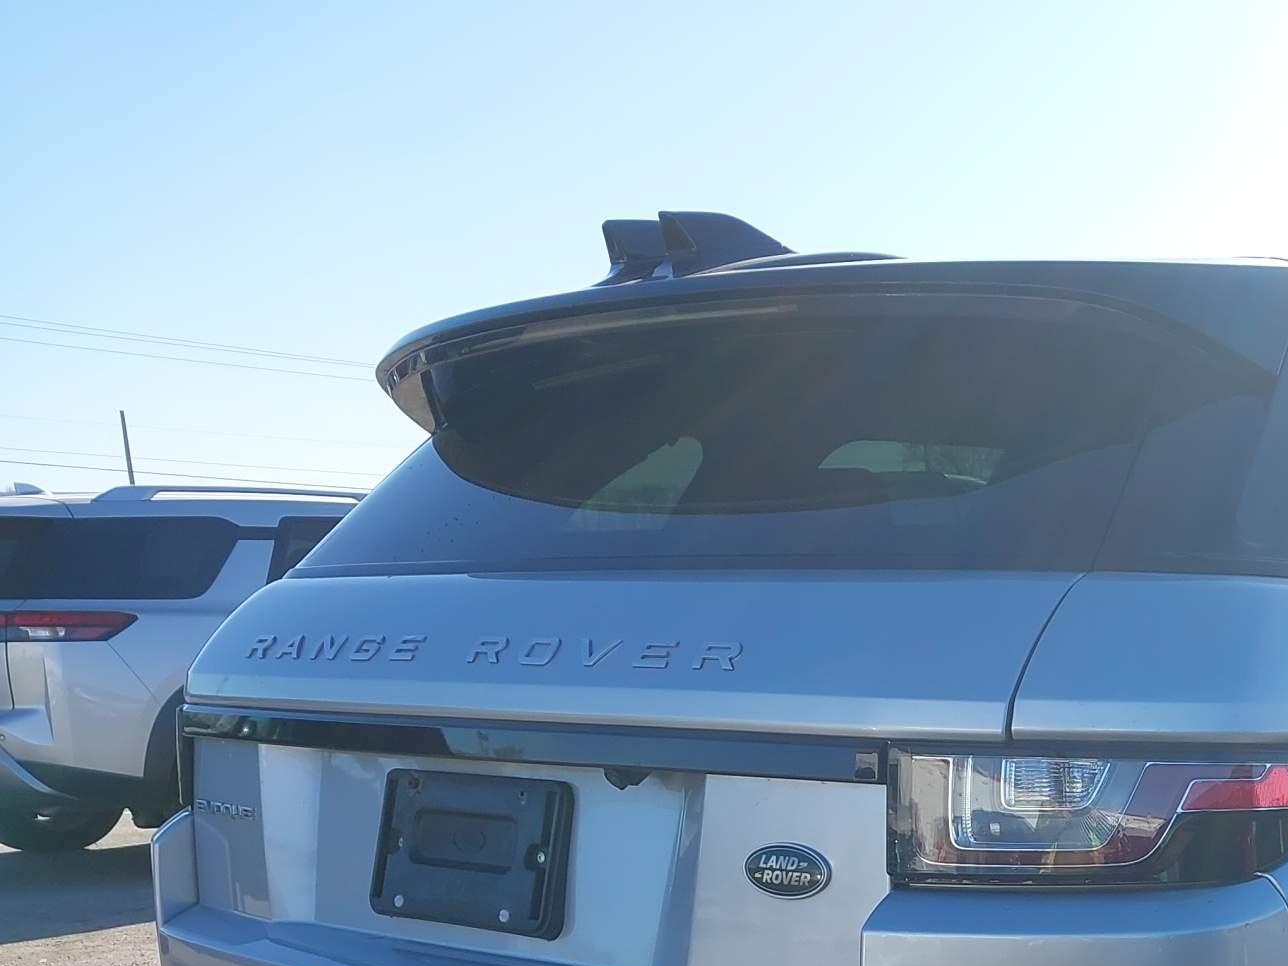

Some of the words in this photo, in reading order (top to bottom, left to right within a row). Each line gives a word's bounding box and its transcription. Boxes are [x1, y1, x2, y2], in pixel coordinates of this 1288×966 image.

[245, 634, 427, 662] RANGE
[465, 637, 744, 672] ROVER
[759, 854, 799, 870] LAND
[762, 869, 811, 886] ROVER
